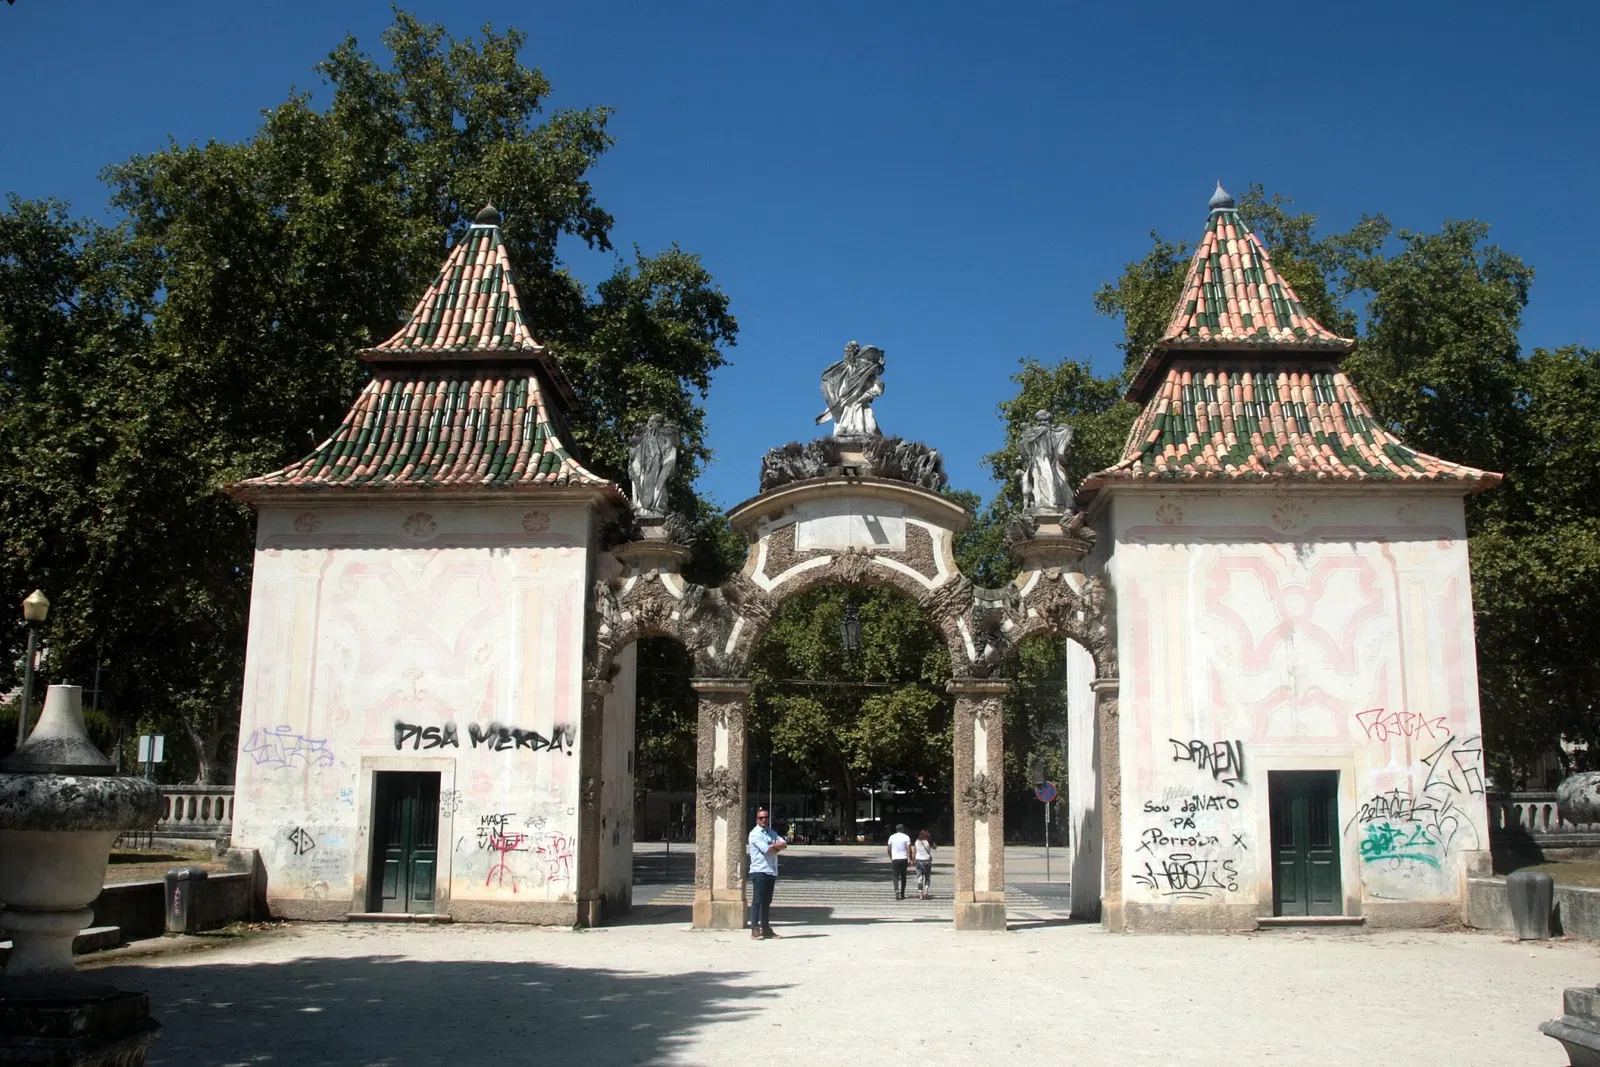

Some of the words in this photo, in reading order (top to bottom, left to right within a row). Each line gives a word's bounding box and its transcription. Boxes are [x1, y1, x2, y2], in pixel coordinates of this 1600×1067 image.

[394, 720, 460, 751] PISA
[468, 722, 577, 757] MERDA!
[1143, 800, 1170, 813] Sou
[1192, 794, 1239, 812] NATO
